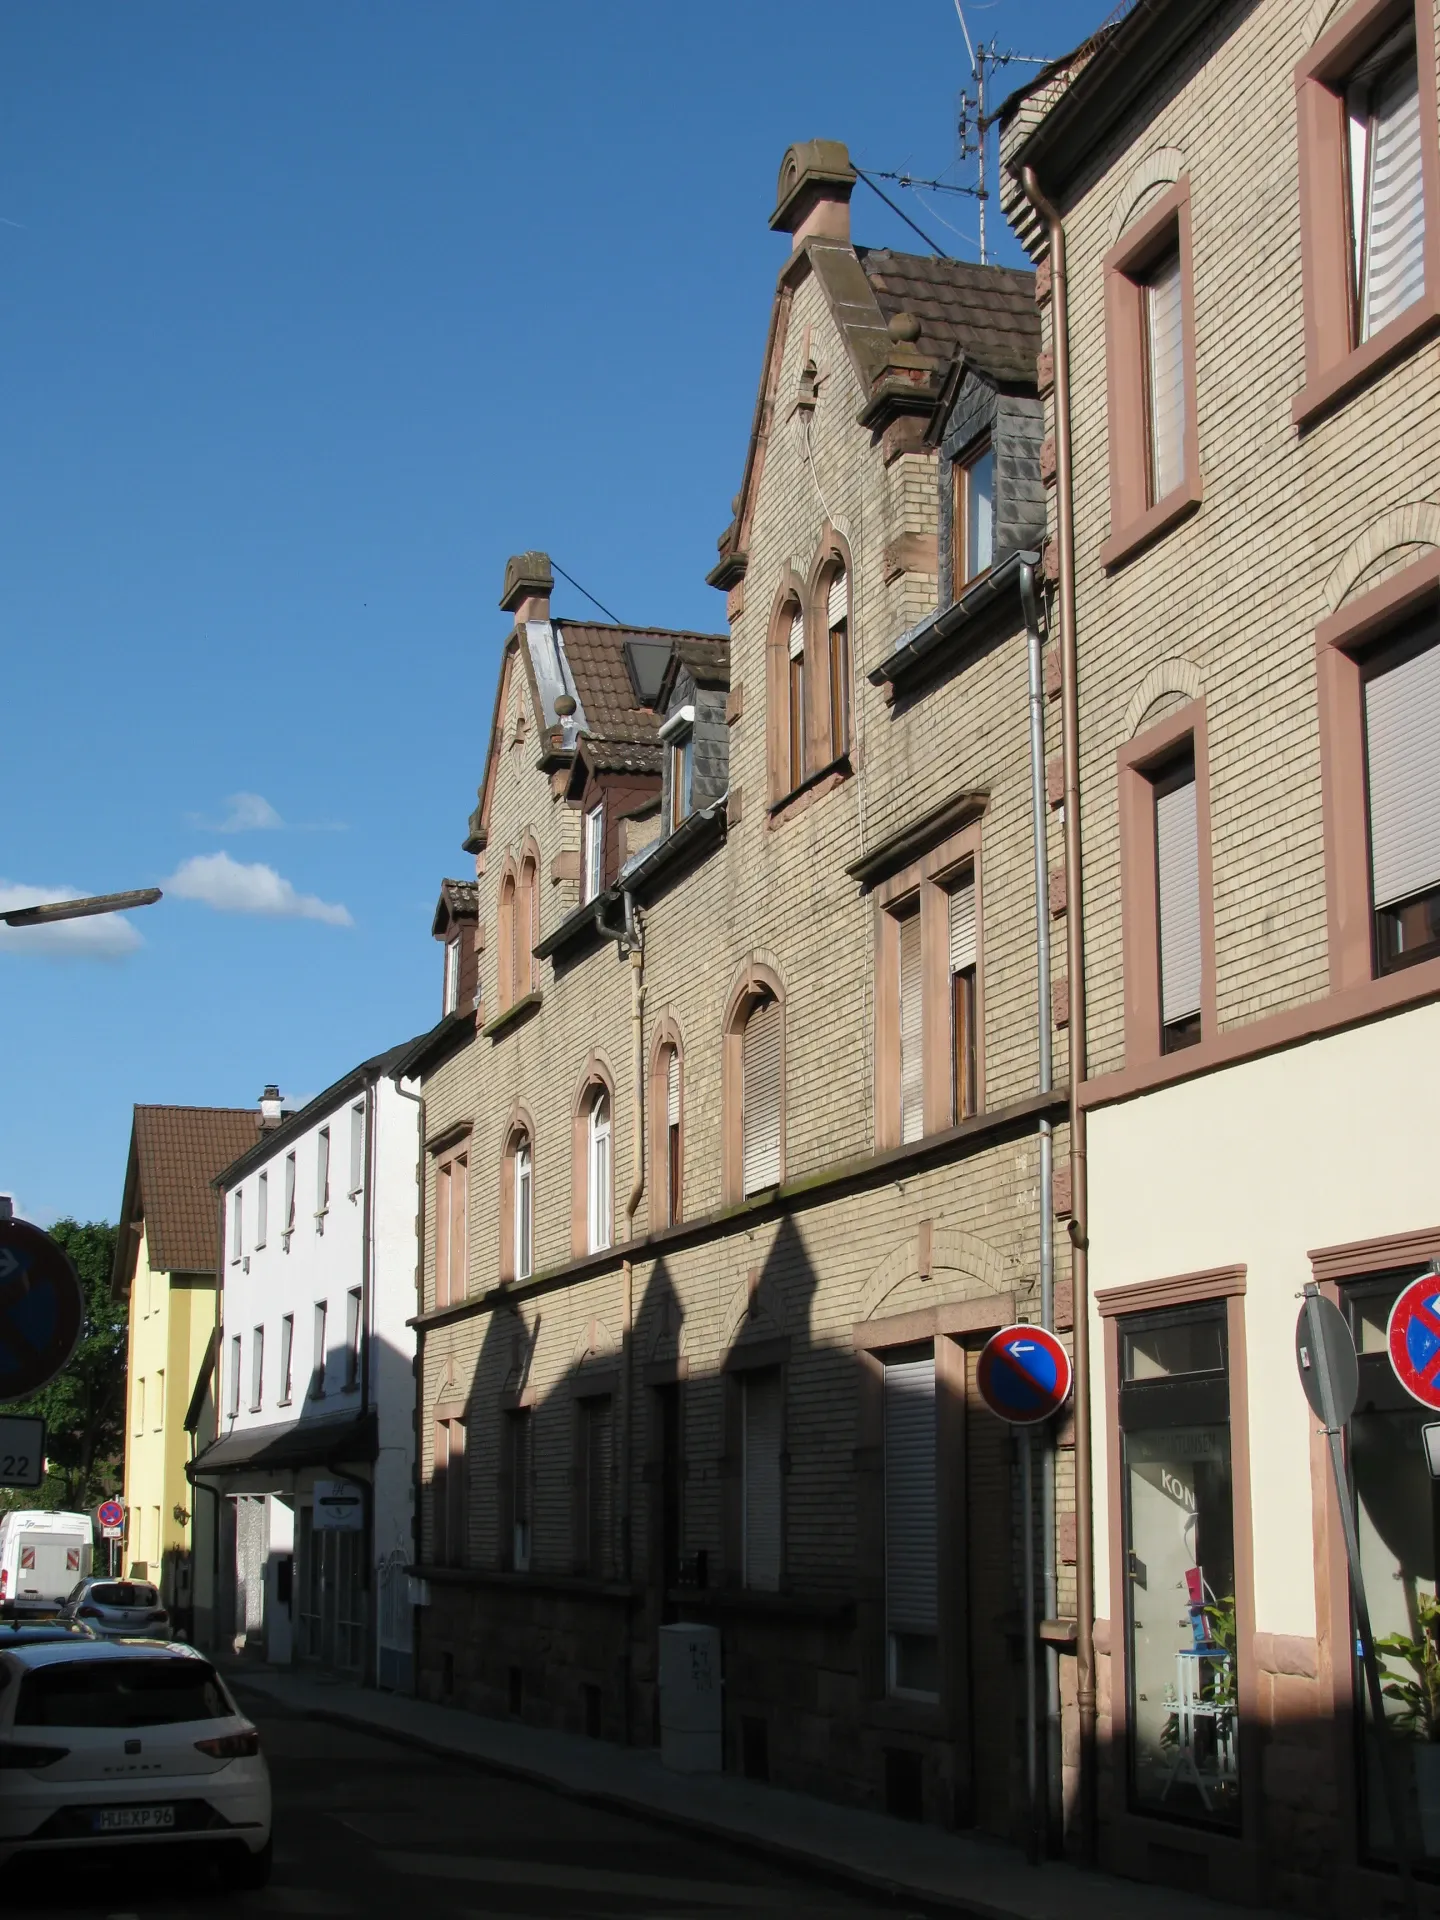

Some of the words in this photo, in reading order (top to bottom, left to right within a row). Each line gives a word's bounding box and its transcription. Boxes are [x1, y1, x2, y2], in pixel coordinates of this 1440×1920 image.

[1161, 1468, 1196, 1511] KON
[102, 1812, 121, 1826] HU
[131, 1811, 150, 1824] XP
[154, 1809, 172, 1823] 96
